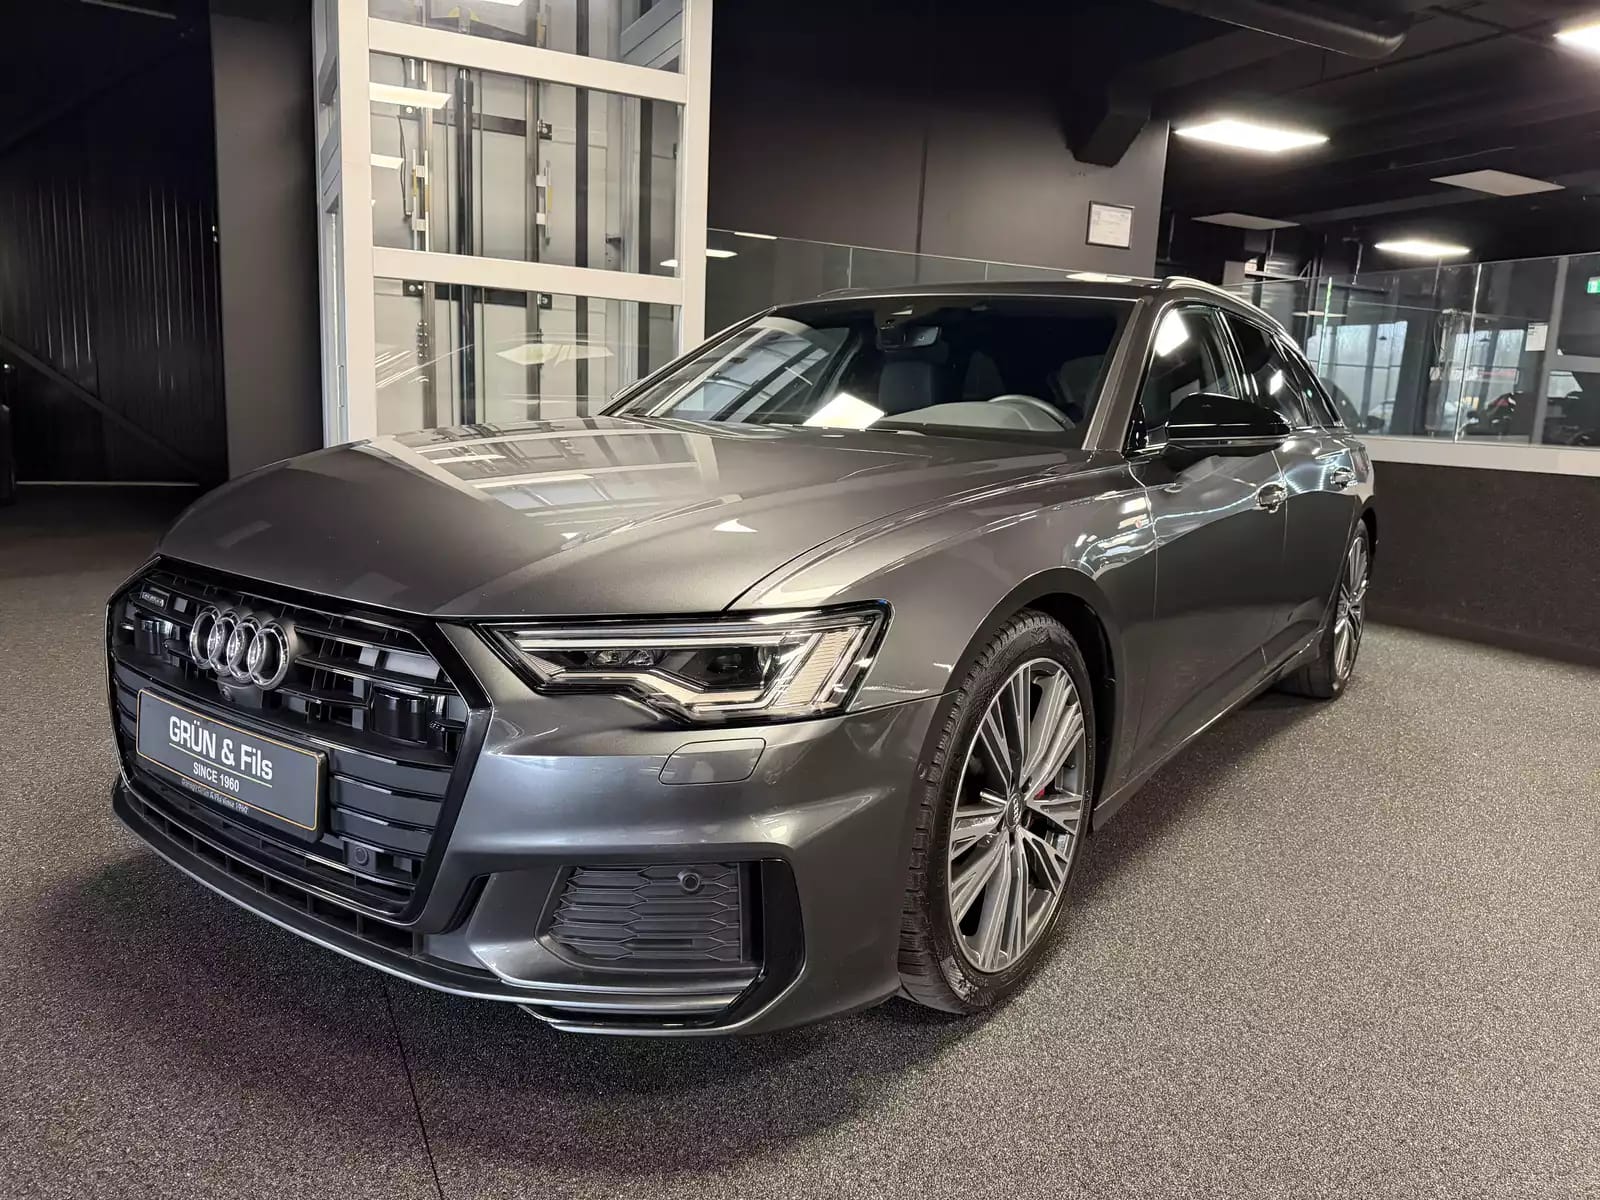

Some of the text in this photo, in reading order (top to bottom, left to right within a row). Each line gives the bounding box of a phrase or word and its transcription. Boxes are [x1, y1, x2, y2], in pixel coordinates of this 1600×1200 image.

[169, 715, 273, 780] GRÜN & Fils
[193, 761, 218, 784] SINCE
[220, 773, 240, 793] 1960
